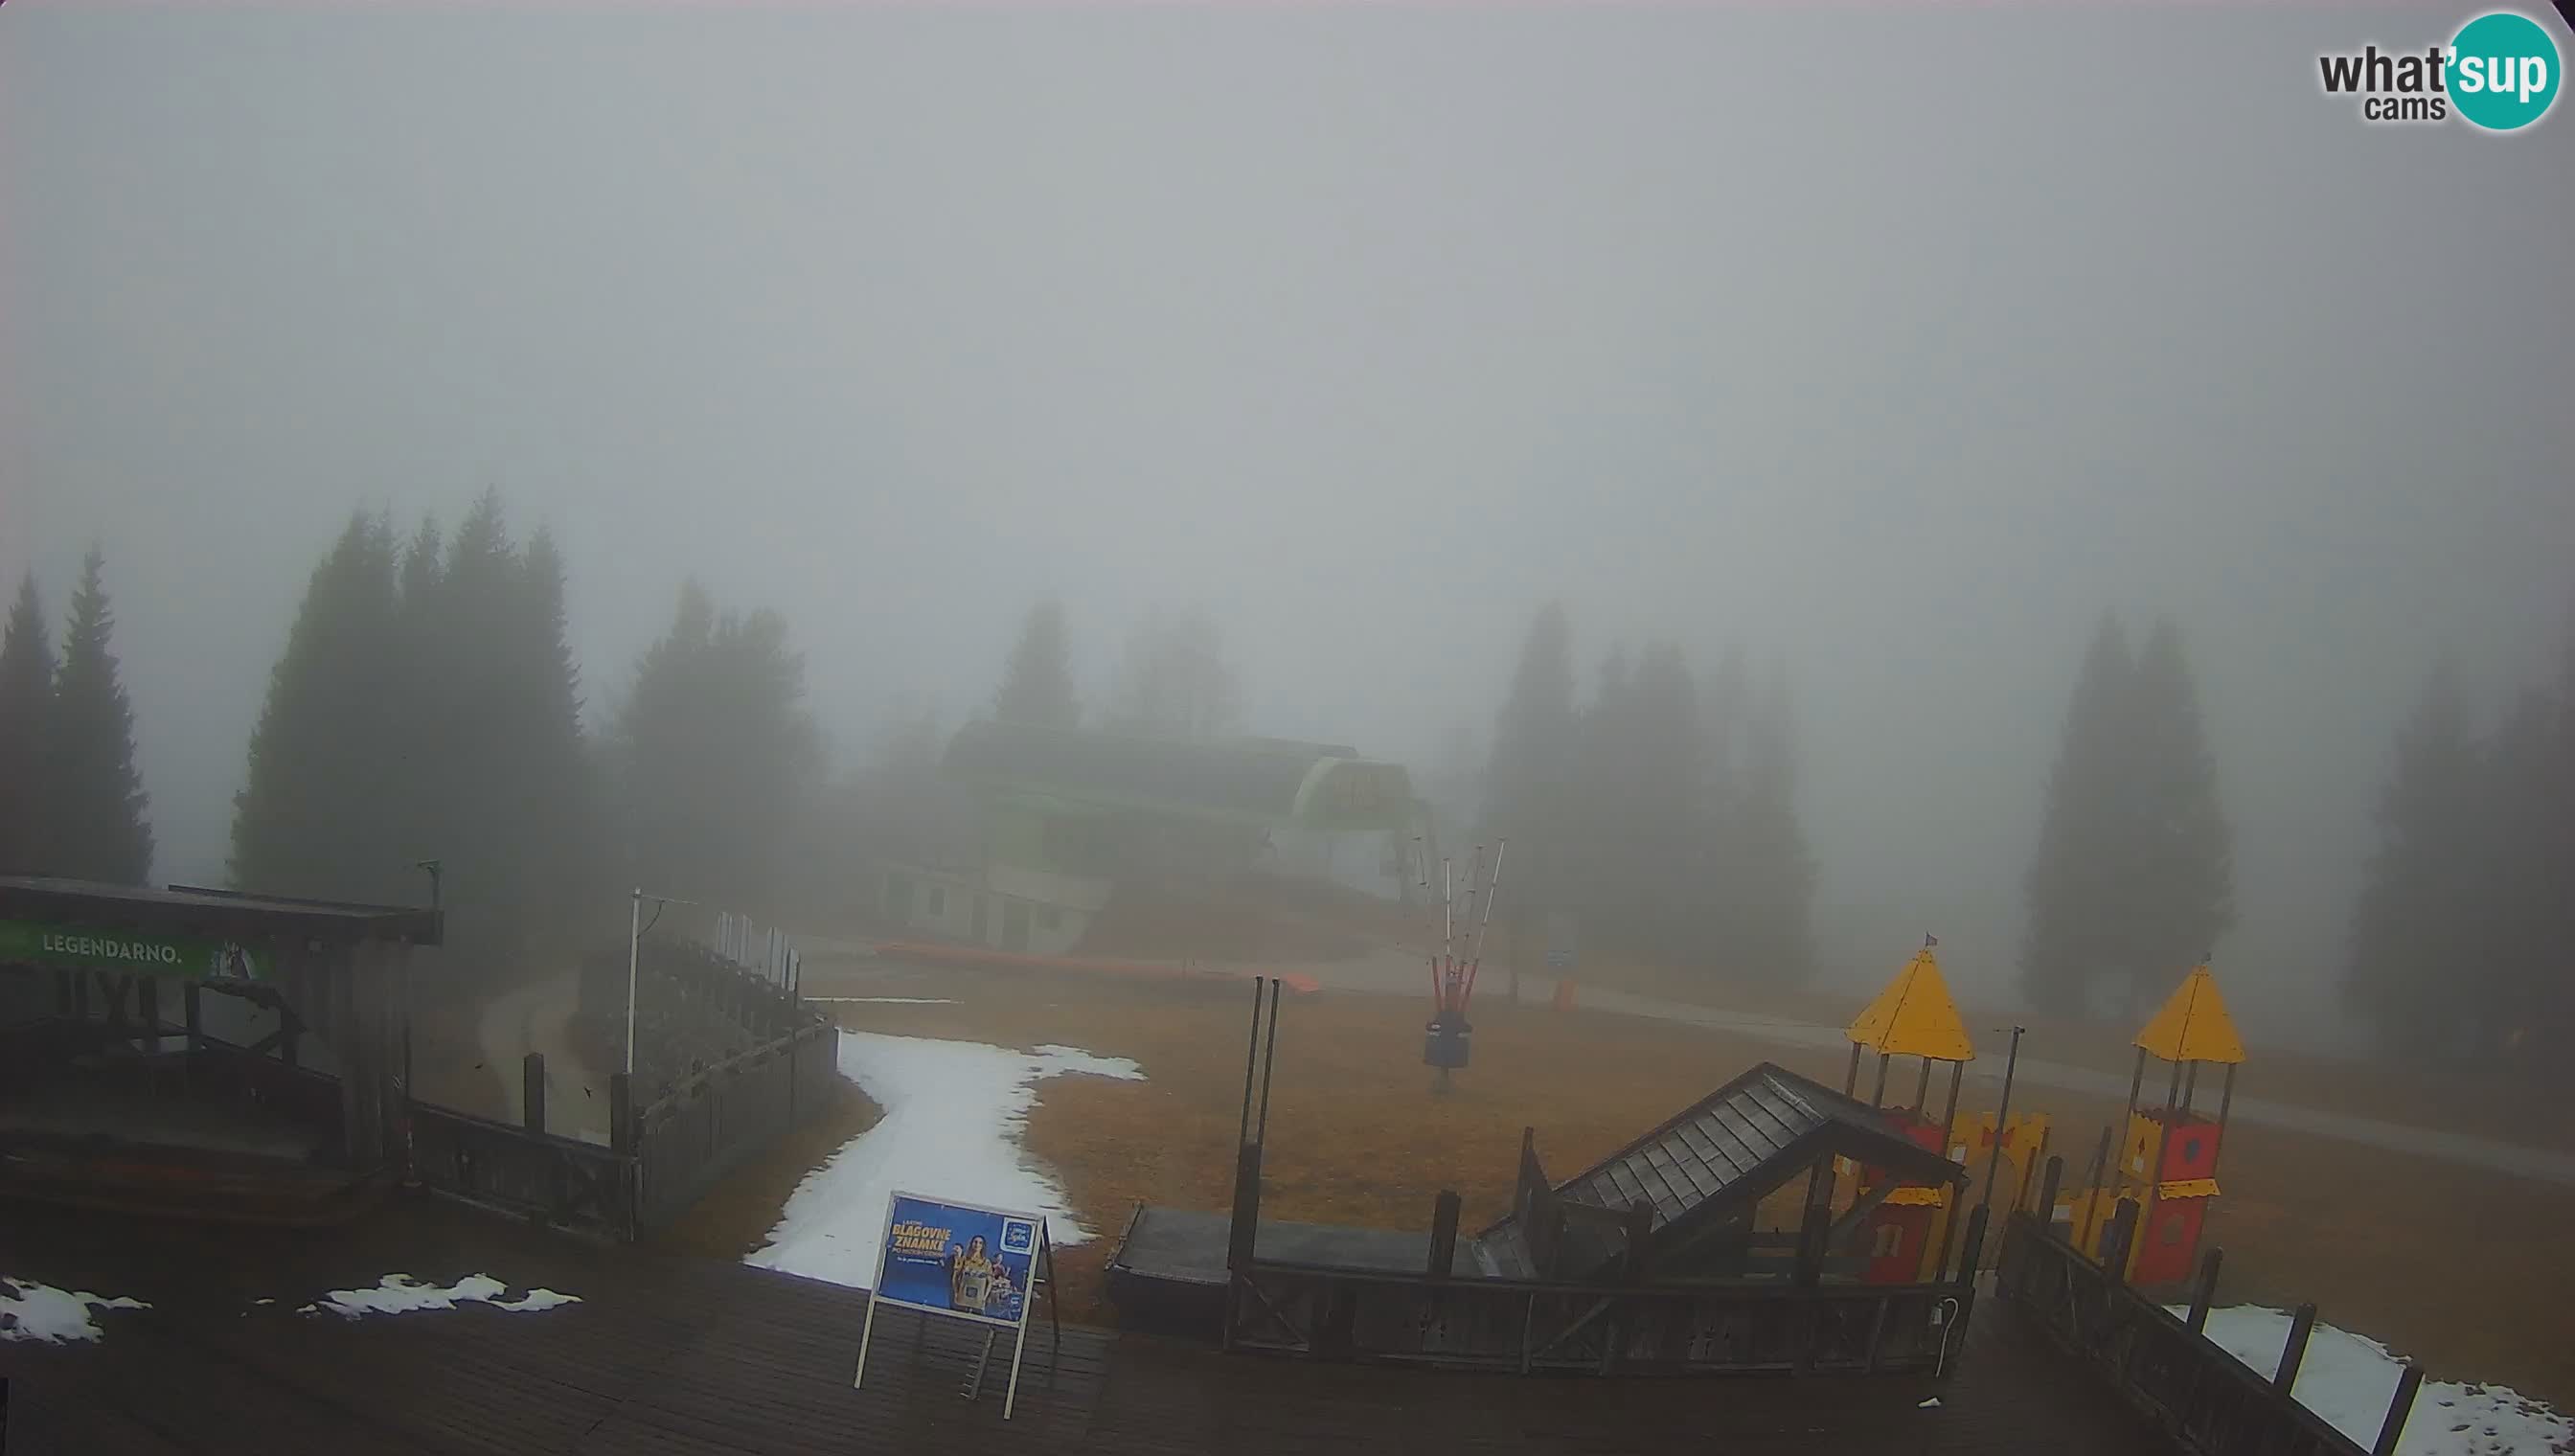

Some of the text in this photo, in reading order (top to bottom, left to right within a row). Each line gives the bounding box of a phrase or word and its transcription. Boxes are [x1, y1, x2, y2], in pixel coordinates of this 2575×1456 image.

[43, 934, 182, 964] LEGENDARNO.
[892, 1224, 951, 1240] BLAGOVNE
[895, 1236, 945, 1251] ZNAMKE
